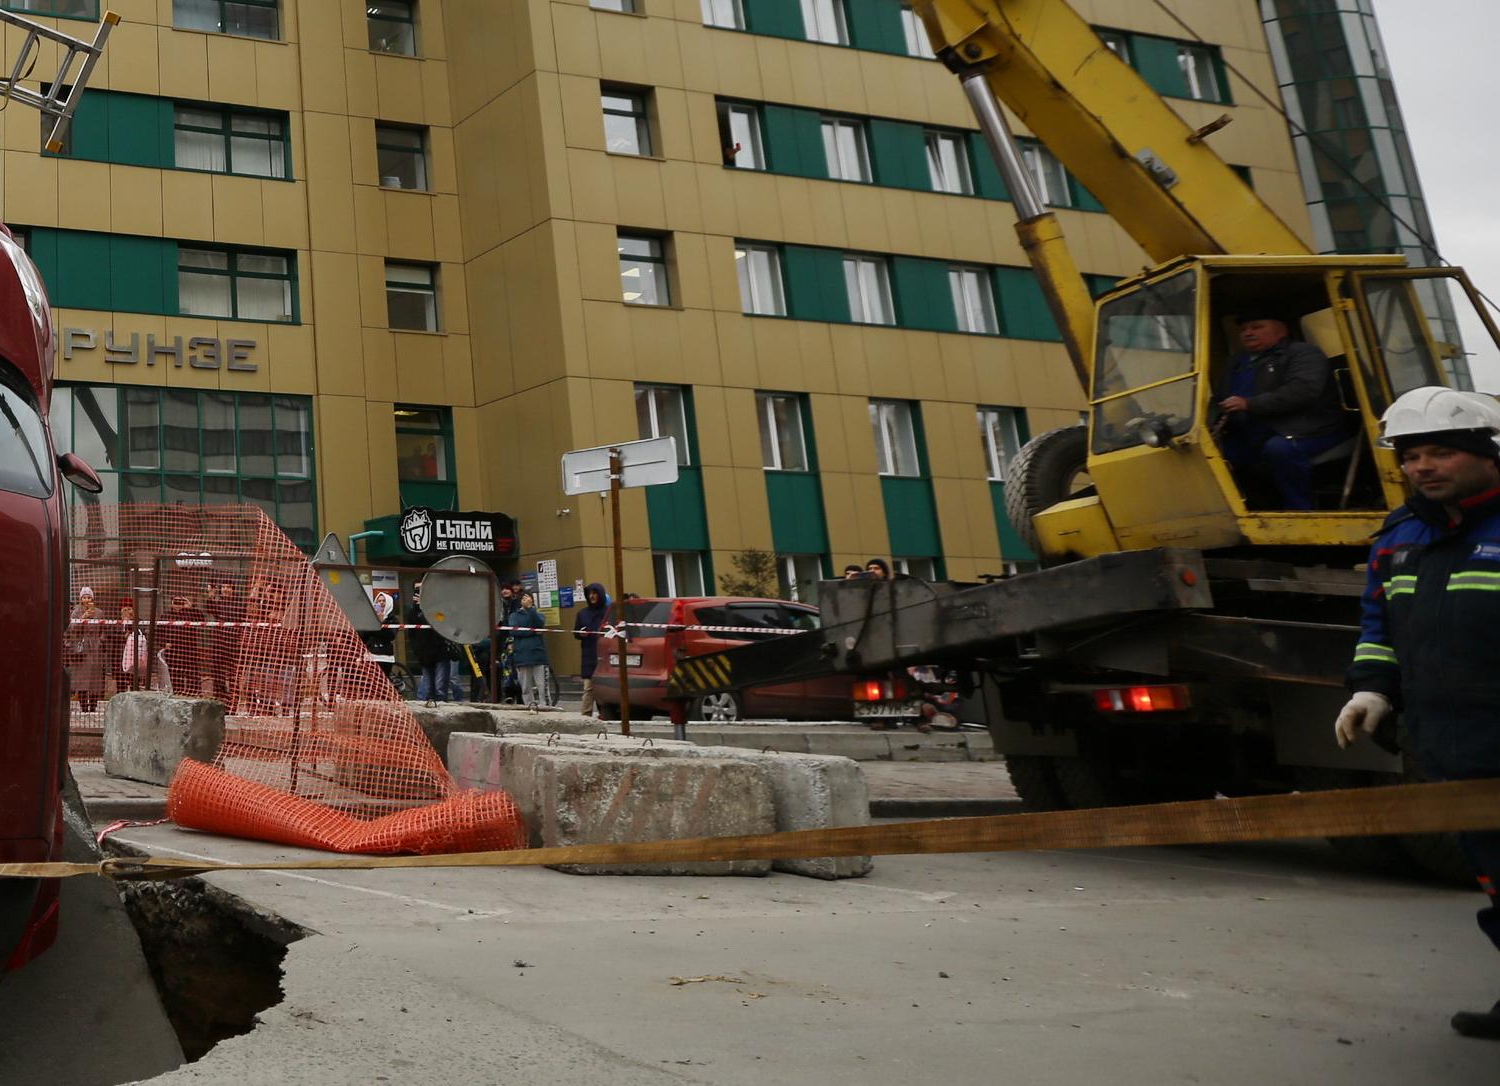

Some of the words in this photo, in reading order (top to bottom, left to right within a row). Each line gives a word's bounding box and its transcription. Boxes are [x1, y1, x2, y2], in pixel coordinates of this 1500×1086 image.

[51, 327, 258, 372] РУНЗЕ
[436, 519, 493, 540] СЫТЫЙ
[436, 540, 448, 550] НЕ
[450, 541, 494, 551] ГОЛОДНЫЙ
